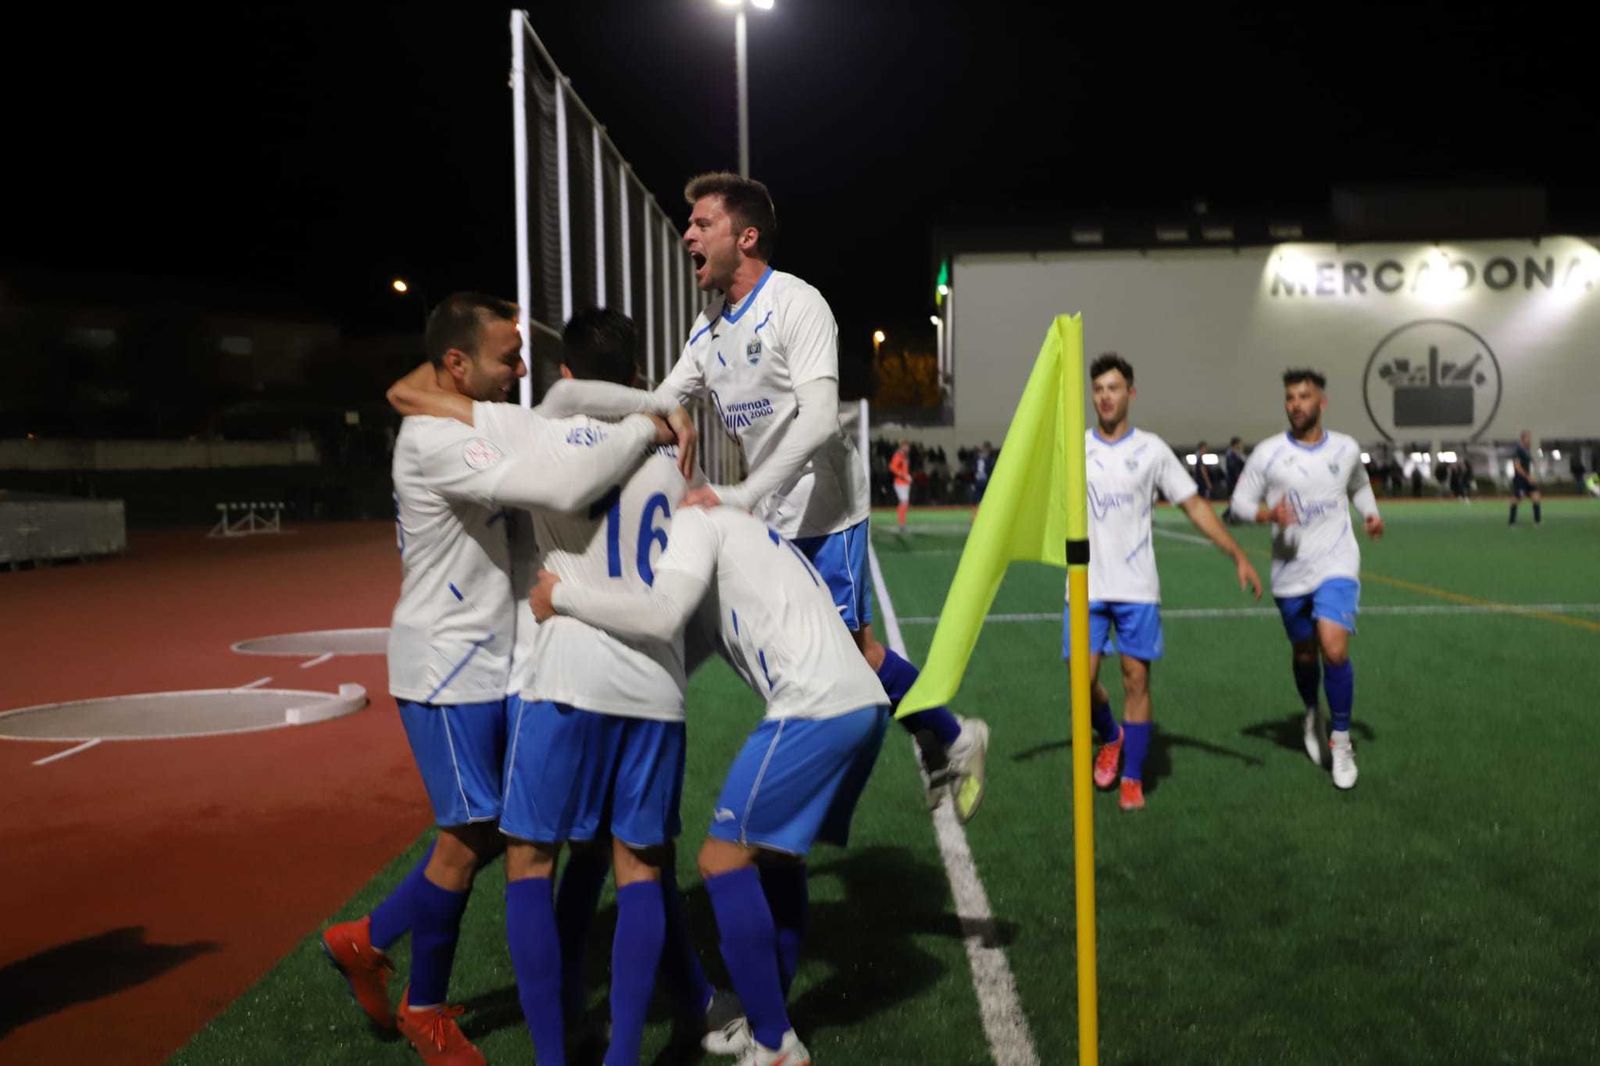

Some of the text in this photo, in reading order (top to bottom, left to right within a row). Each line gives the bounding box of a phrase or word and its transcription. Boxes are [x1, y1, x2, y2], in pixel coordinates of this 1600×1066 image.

[726, 398, 771, 413] vivienda
[750, 406, 774, 419] 2000
[588, 485, 671, 588] 16
